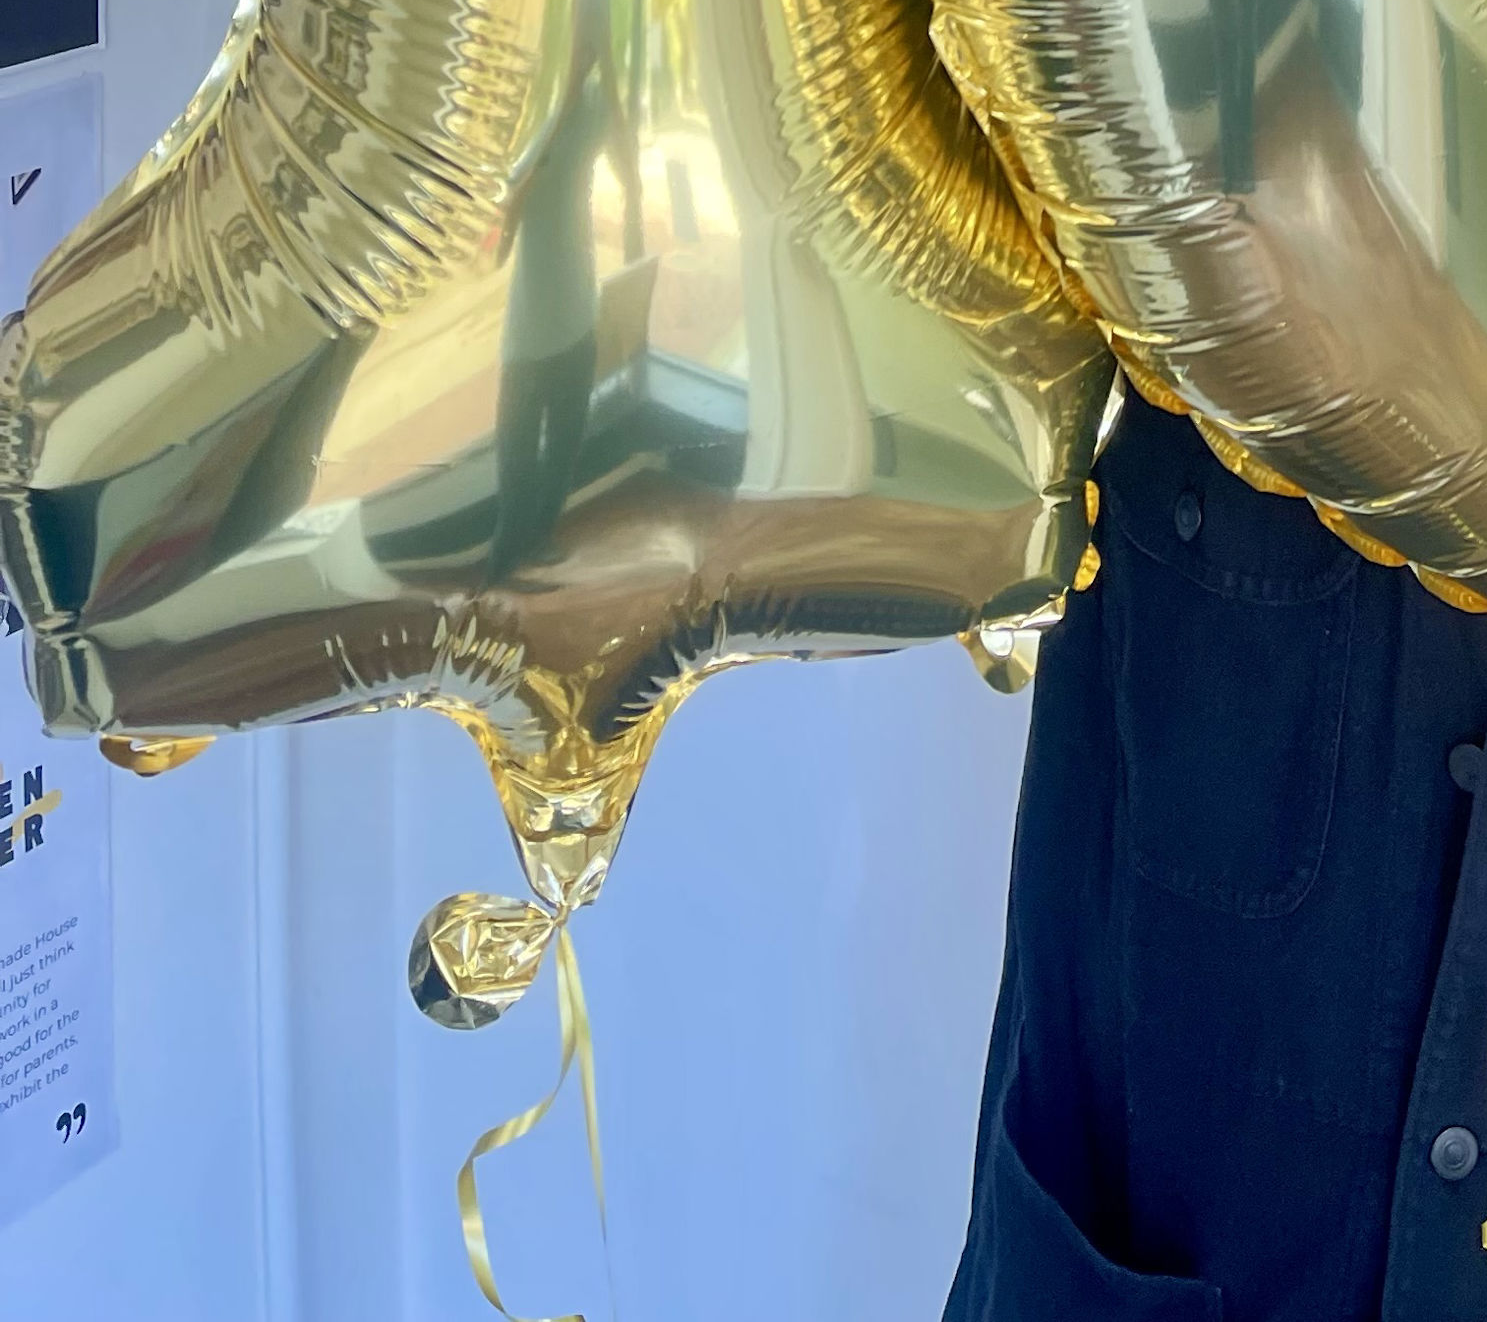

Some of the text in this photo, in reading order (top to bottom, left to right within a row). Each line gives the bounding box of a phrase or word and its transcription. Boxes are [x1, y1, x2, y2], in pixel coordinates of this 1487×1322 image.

[36, 916, 78, 949] House
[9, 964, 35, 993] just
[39, 941, 74, 970] think
[0, 978, 51, 1017] nity for
[34, 1006, 47, 1021] in
[50, 999, 58, 1011] a
[35, 1024, 53, 1044] for
[57, 1010, 80, 1030] the
[0, 1069, 20, 1088] for
[46, 1063, 69, 1085] the
